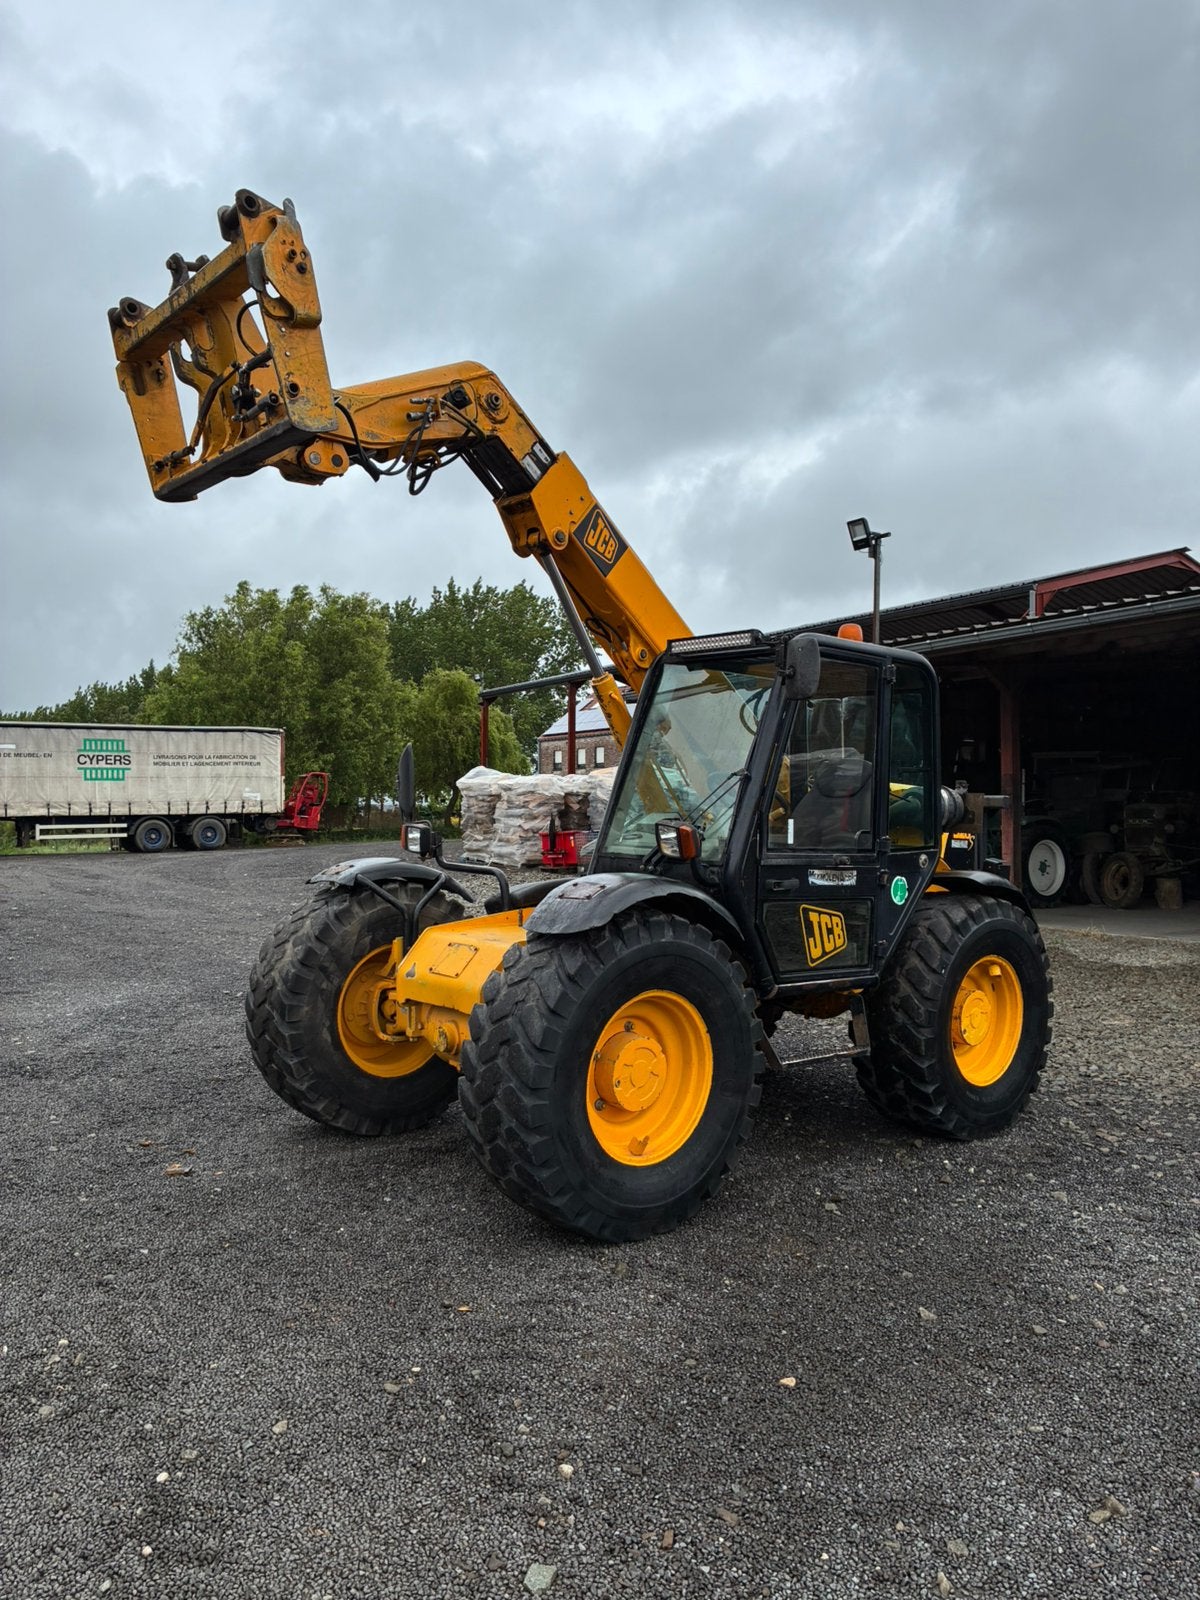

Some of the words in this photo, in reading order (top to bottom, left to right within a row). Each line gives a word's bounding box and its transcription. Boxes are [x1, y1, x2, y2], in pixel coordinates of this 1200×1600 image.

[587, 517, 616, 560] JCB
[77, 754, 132, 766] CYPERS
[808, 911, 845, 960] JCB
